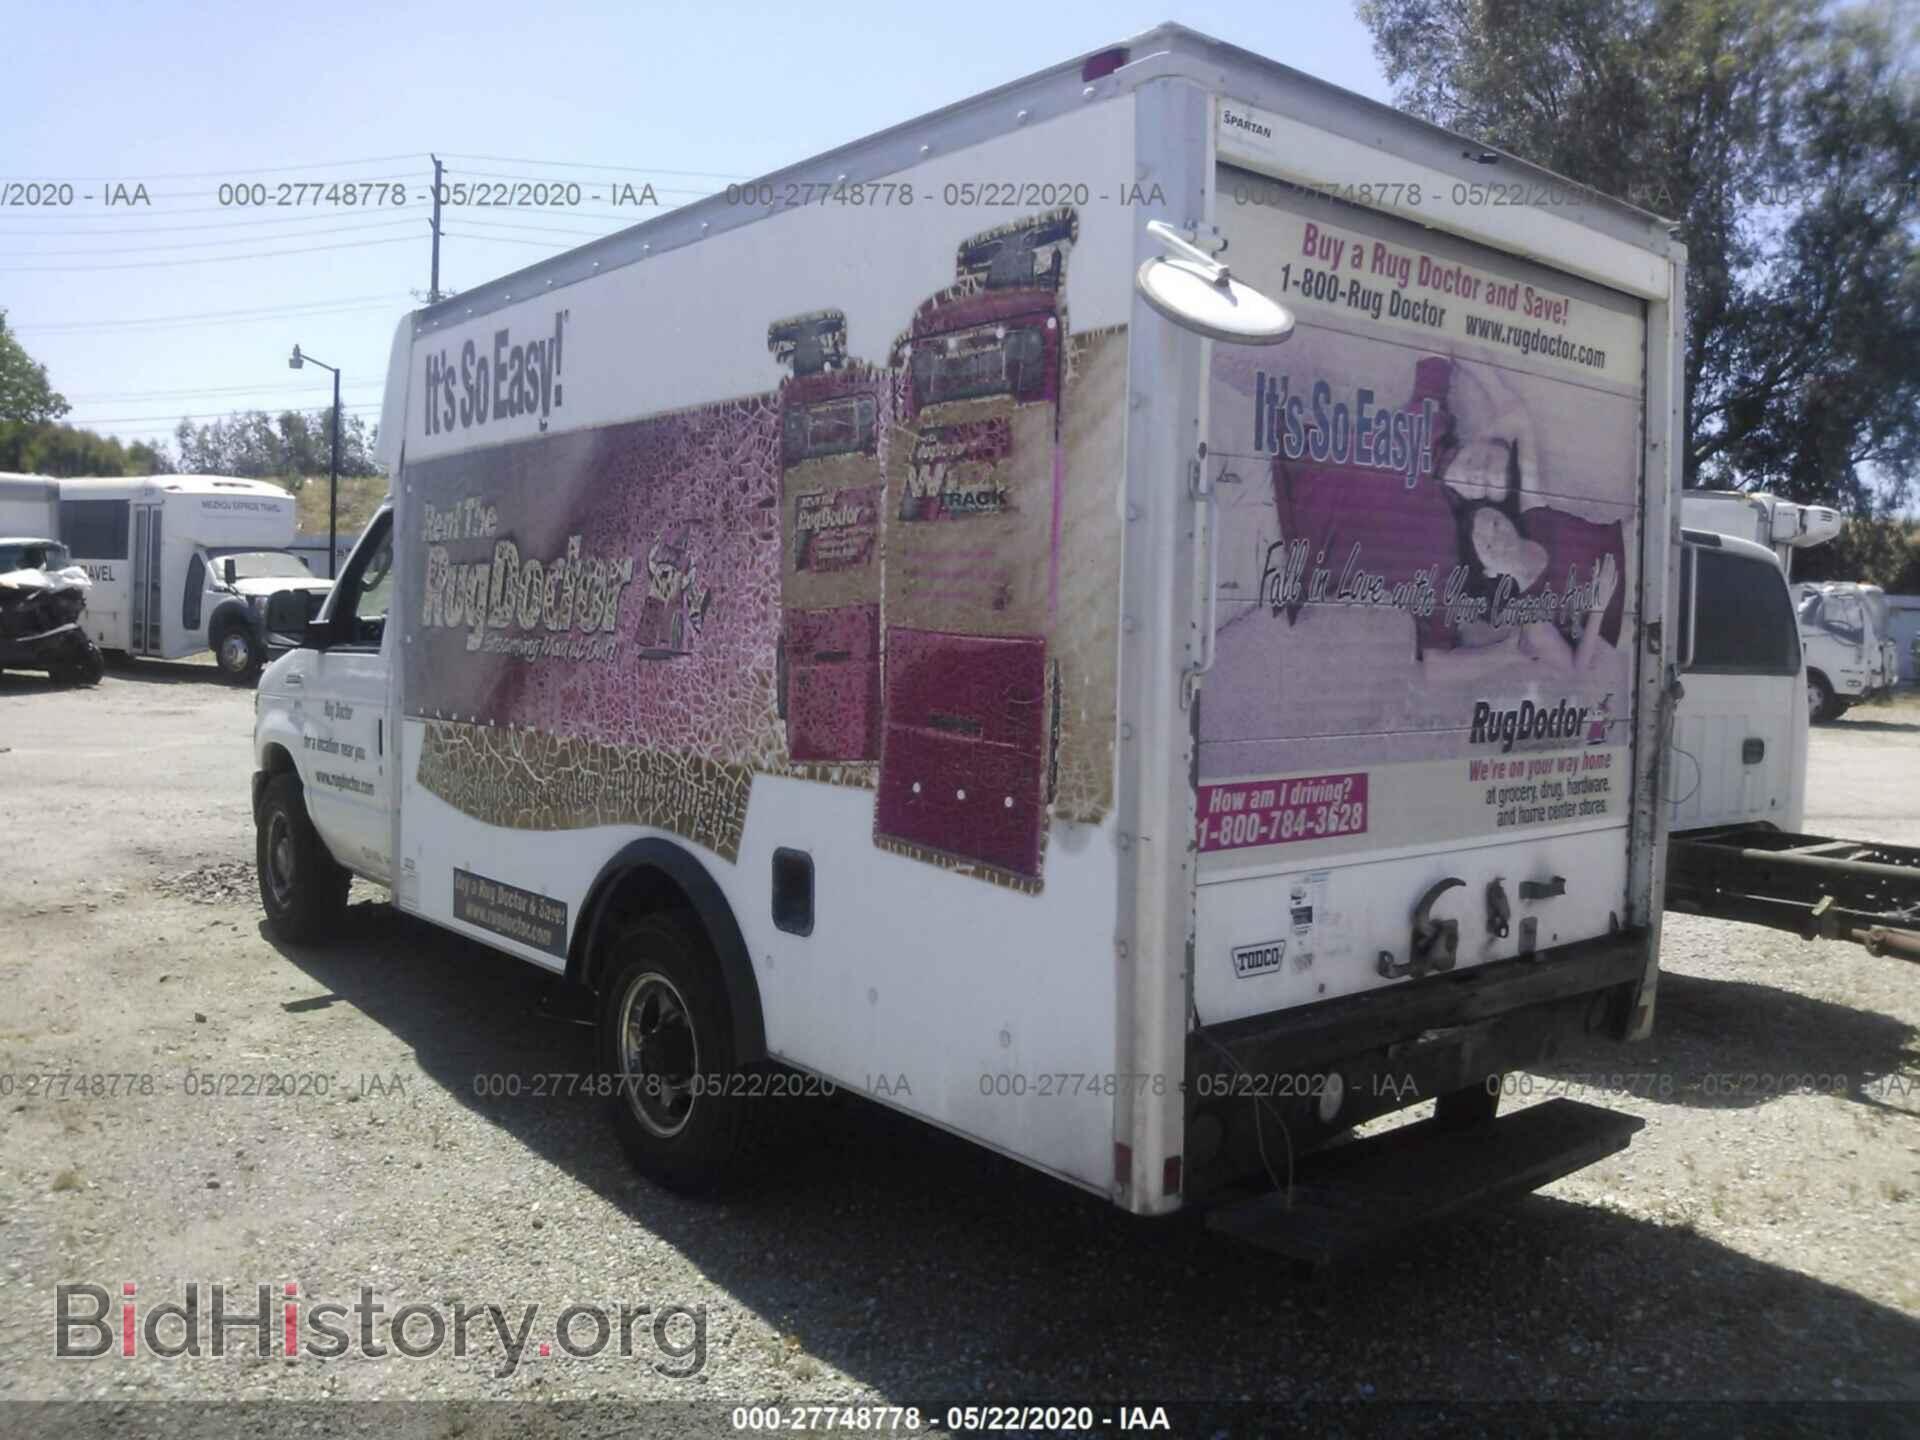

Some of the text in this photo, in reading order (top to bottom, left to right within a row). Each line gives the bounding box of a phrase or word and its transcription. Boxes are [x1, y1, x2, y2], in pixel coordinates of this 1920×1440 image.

[1223, 109, 1272, 139] SPARTAN
[1302, 222, 1570, 328] Buy a Rug Doctor and Save!
[1281, 262, 1607, 370] 1-800-Rug Doctor www.rugdoctor.com
[424, 348, 457, 437] It's
[460, 338, 490, 429] So
[1254, 371, 1434, 489] It's So Easy!
[1259, 537, 1311, 608] Fall
[1310, 550, 1332, 602] in
[1337, 540, 1386, 604] Love
[1469, 697, 1590, 754] RugDoctor
[1470, 749, 1613, 783] We're on your way home
[1209, 776, 1353, 814] How am I driving?
[1485, 785, 1497, 805] at
[1496, 805, 1516, 828] and
[1518, 804, 1546, 825] home
[1547, 800, 1578, 821] center
[1197, 801, 1364, 849] 1-800-784-3628
[1237, 947, 1279, 971] TODCO
